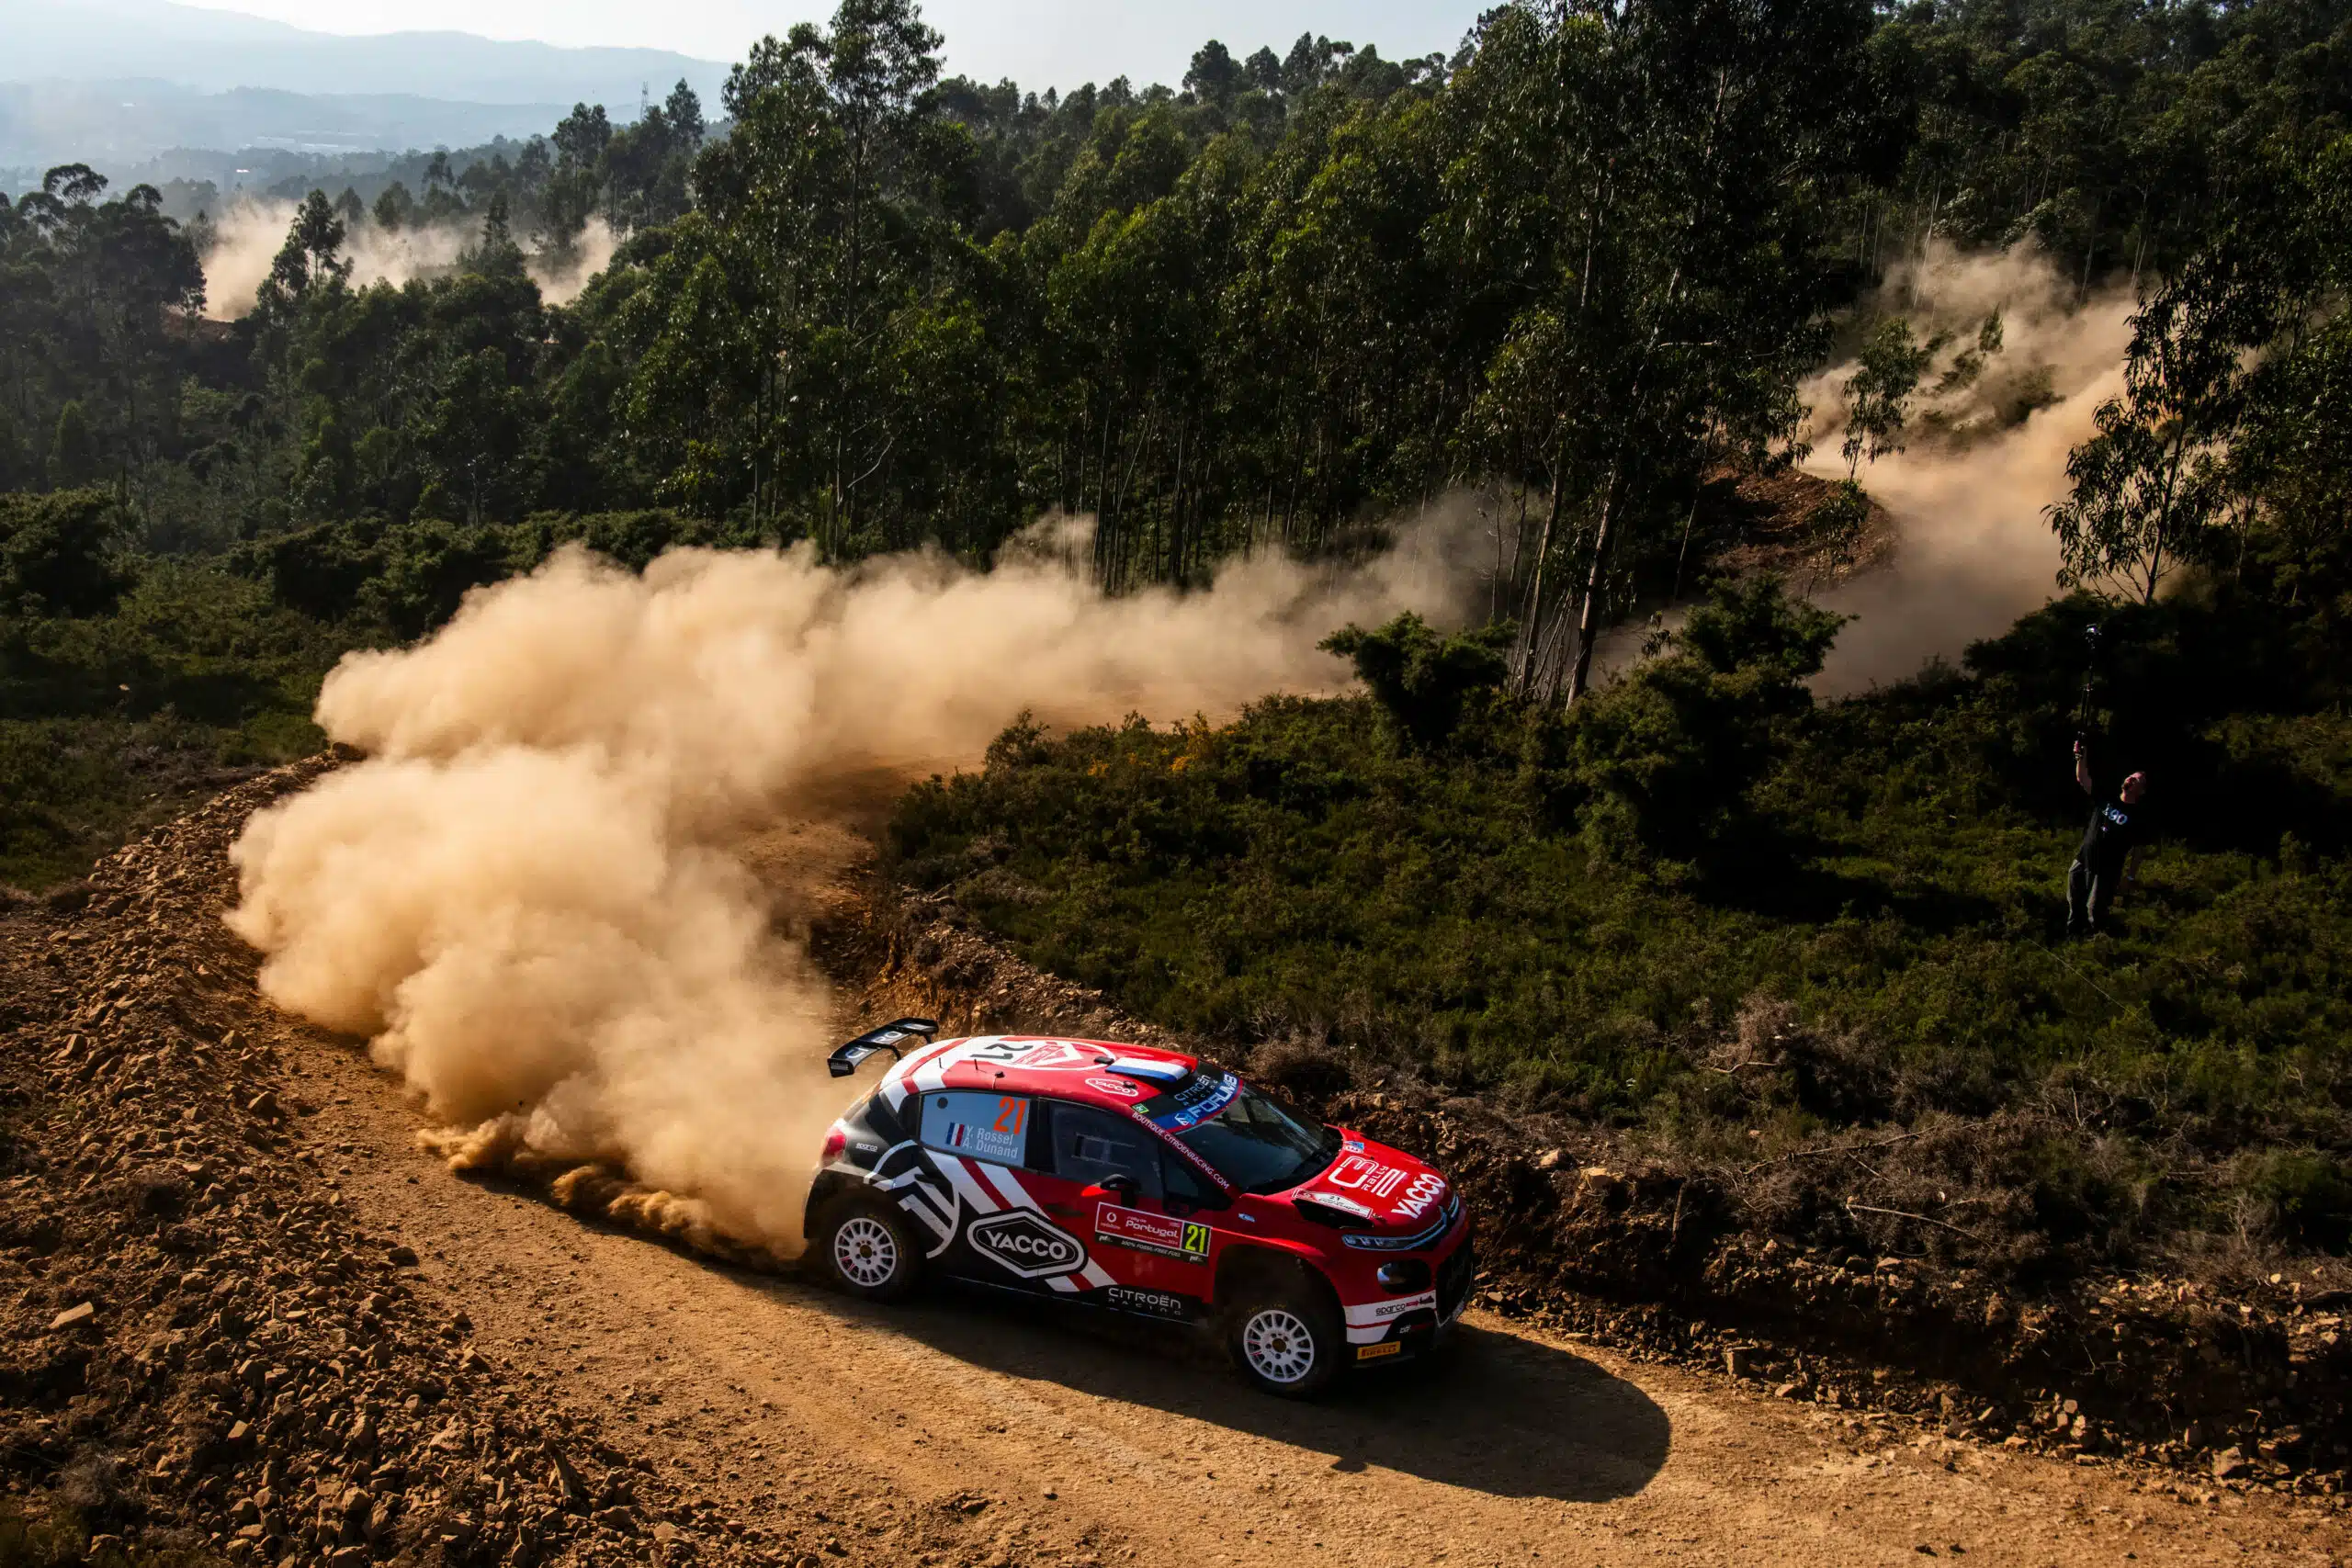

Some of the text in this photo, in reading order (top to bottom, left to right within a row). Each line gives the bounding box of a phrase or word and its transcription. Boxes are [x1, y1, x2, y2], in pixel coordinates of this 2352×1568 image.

[1093, 1078, 1131, 1094] YACCO
[993, 1096, 1027, 1135] 21
[966, 1124, 1015, 1147] Y. Rossel
[962, 1138, 1019, 1159] A. Dunand
[1328, 1156, 1379, 1189] C3
[1391, 1173, 1446, 1219] YACCO
[1125, 1220, 1179, 1239] Portugal
[1184, 1224, 1206, 1254] 21
[985, 1230, 1067, 1260] YACCO
[1108, 1287, 1182, 1309] CITROËN
[1375, 1303, 1406, 1316] sparco
